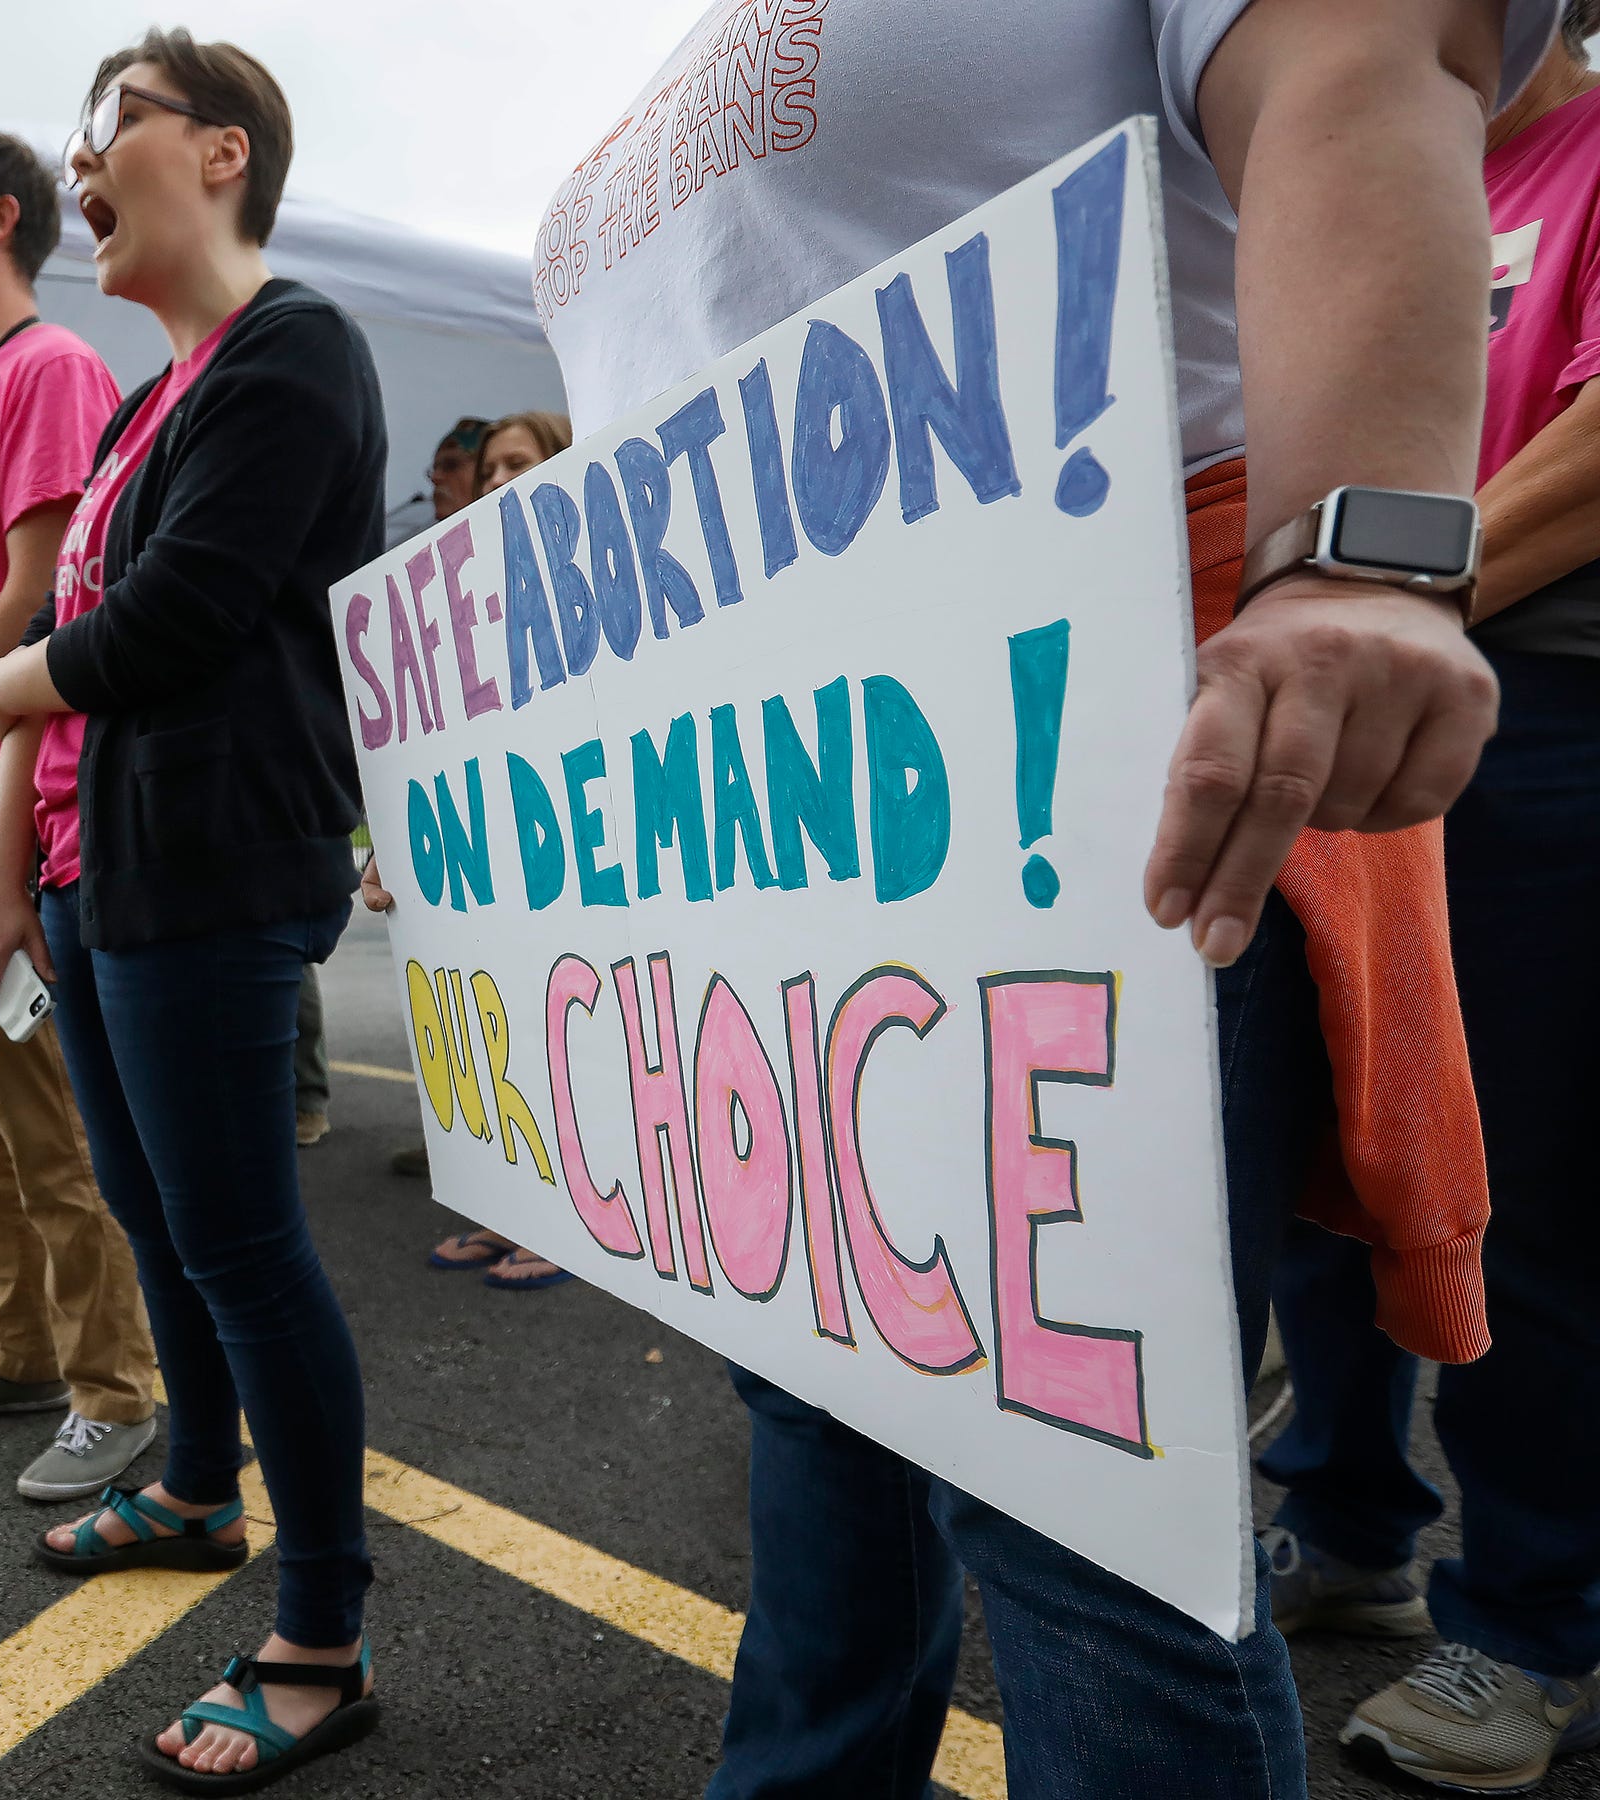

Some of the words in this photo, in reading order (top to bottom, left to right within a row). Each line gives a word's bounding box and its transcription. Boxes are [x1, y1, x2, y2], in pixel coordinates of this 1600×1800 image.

[670, 17, 823, 154] BANS
[598, 169, 661, 271] THE
[669, 78, 818, 210] BANS
[406, 757, 495, 912] ON
[405, 957, 556, 1188] OUR
[546, 950, 1165, 1460] CHOICE
